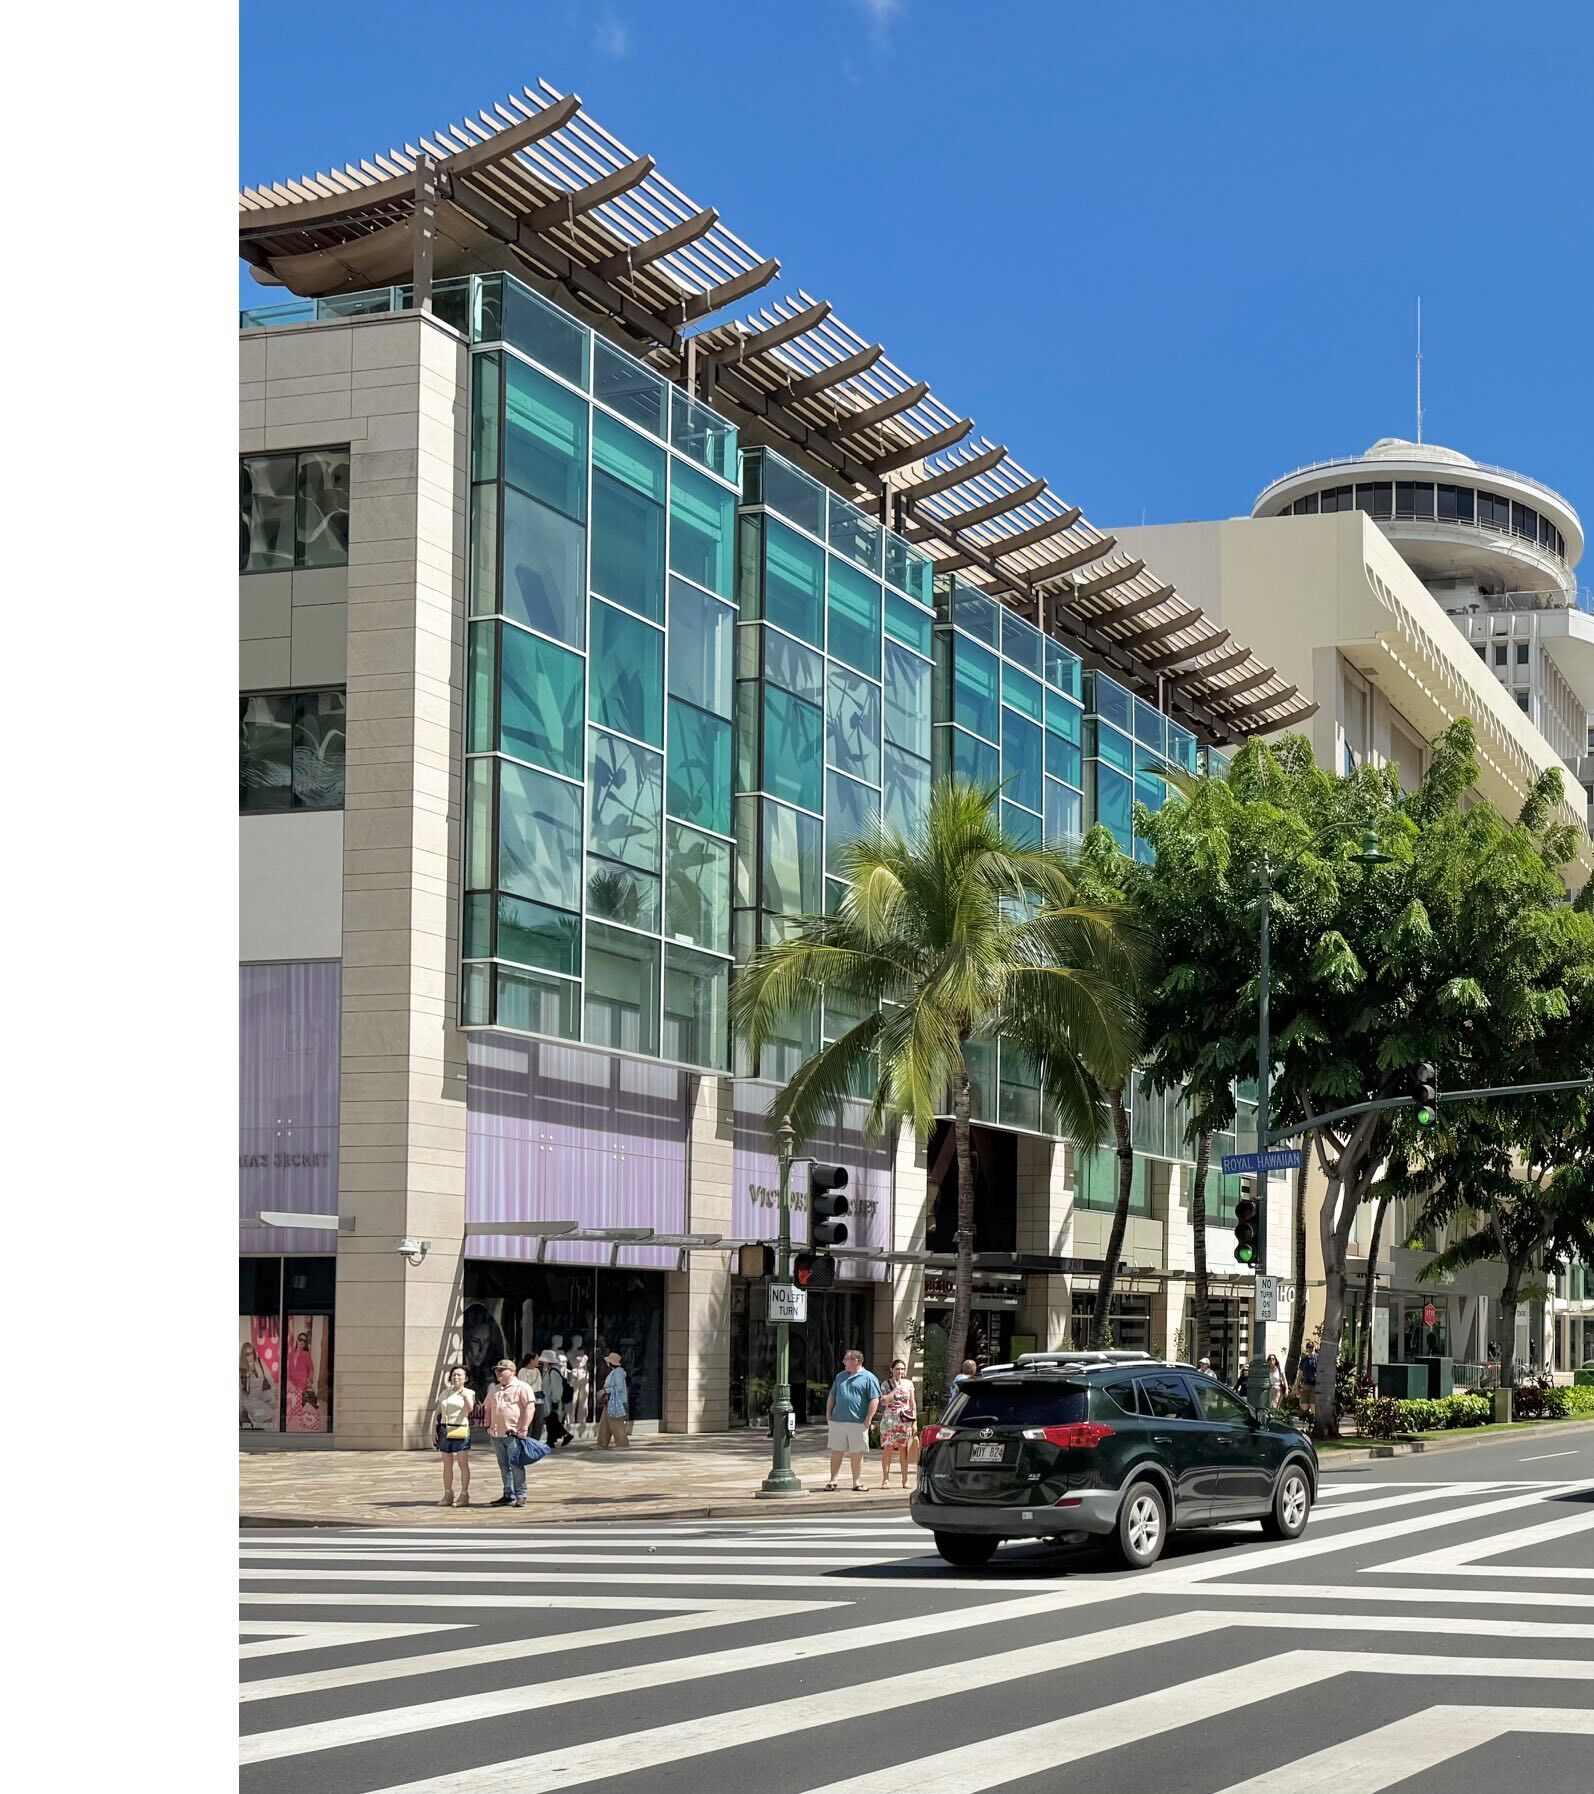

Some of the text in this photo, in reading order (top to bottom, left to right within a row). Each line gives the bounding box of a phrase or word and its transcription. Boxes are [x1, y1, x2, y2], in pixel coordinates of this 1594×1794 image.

[1223, 1152, 1301, 1172] ROYAL HAWAIIAN
[1262, 1278, 1272, 1289] NO
[772, 1289, 804, 1304] NO LEFT
[1260, 1290, 1273, 1299] TURN
[779, 1306, 799, 1316] TURN
